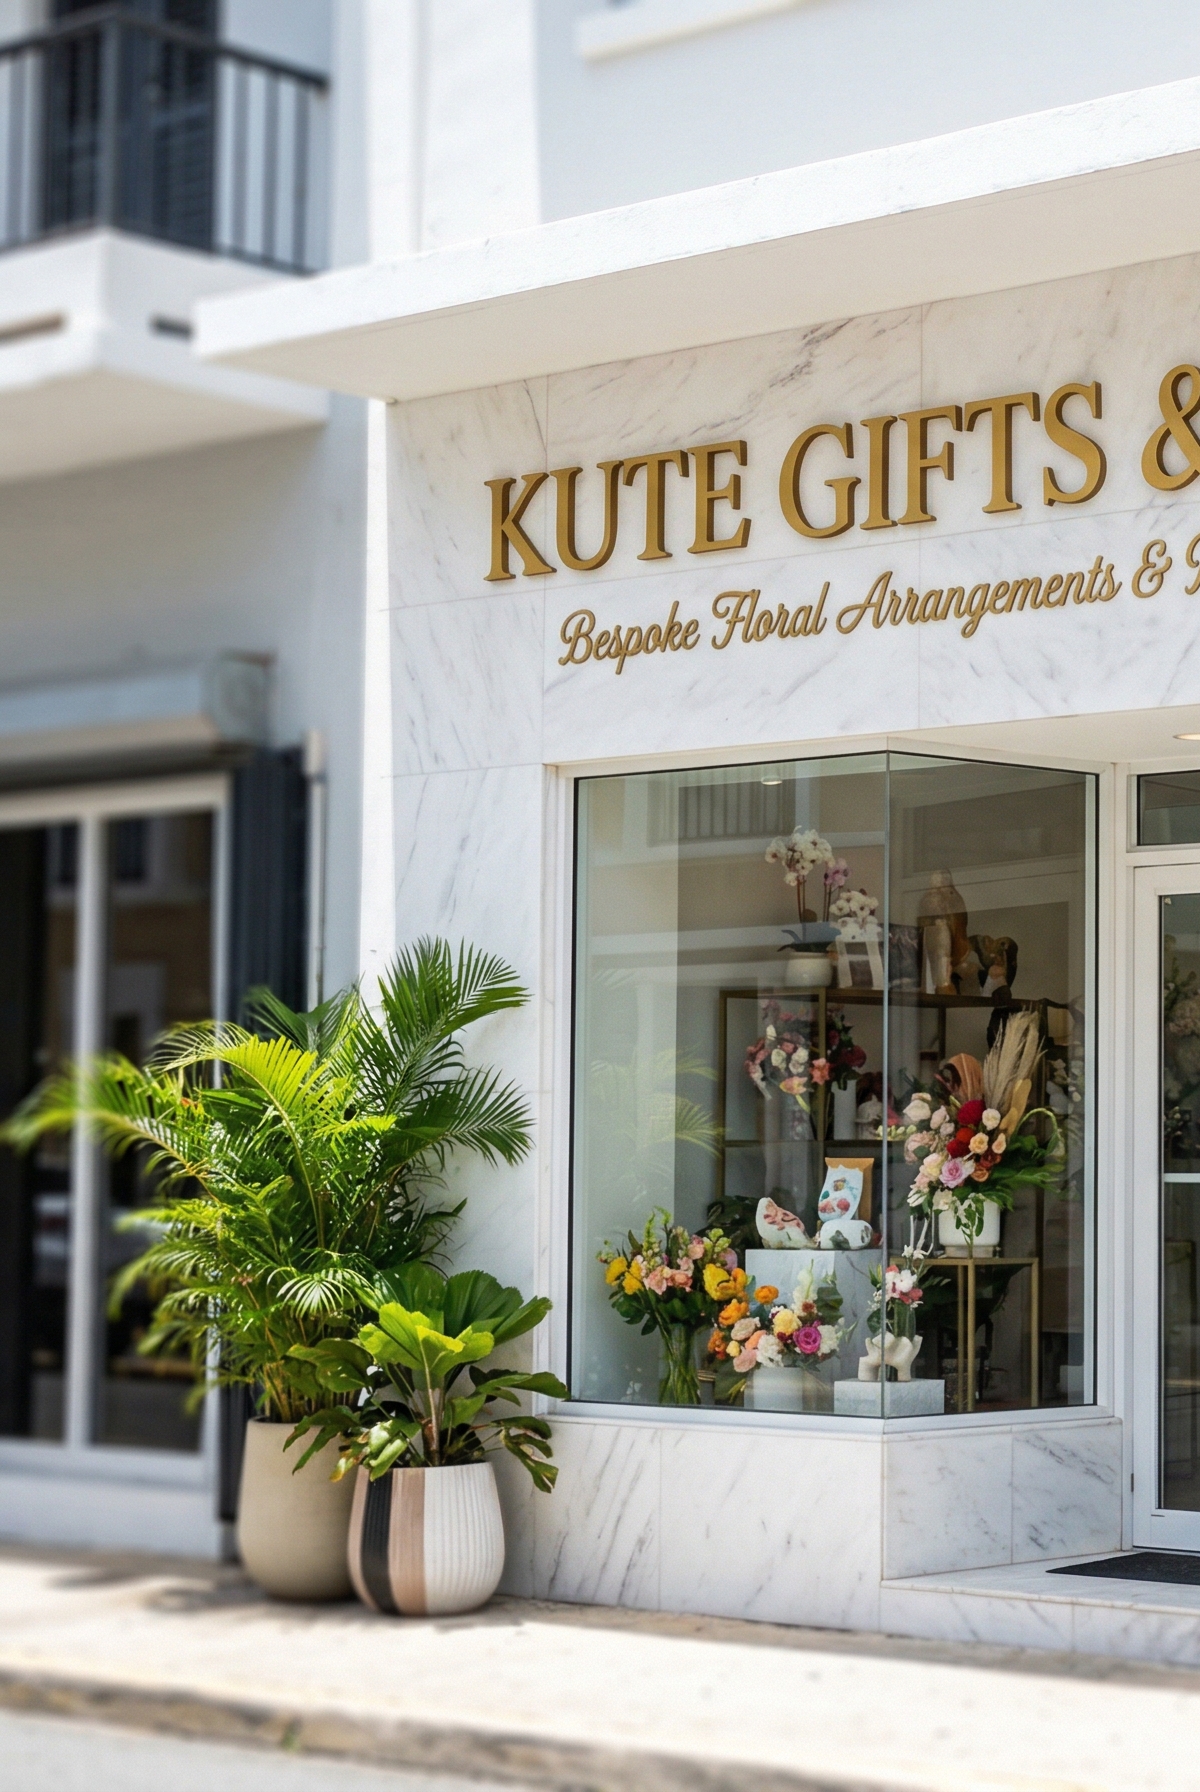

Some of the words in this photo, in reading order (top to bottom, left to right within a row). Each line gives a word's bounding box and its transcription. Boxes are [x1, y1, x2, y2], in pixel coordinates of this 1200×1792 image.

[484, 440, 751, 581] KUTE
[779, 381, 1106, 539] GIFTS
[558, 601, 700, 675] Bespoke
[711, 582, 830, 650] Floral
[837, 557, 1120, 638] Arrangements
[1132, 540, 1172, 598] &
